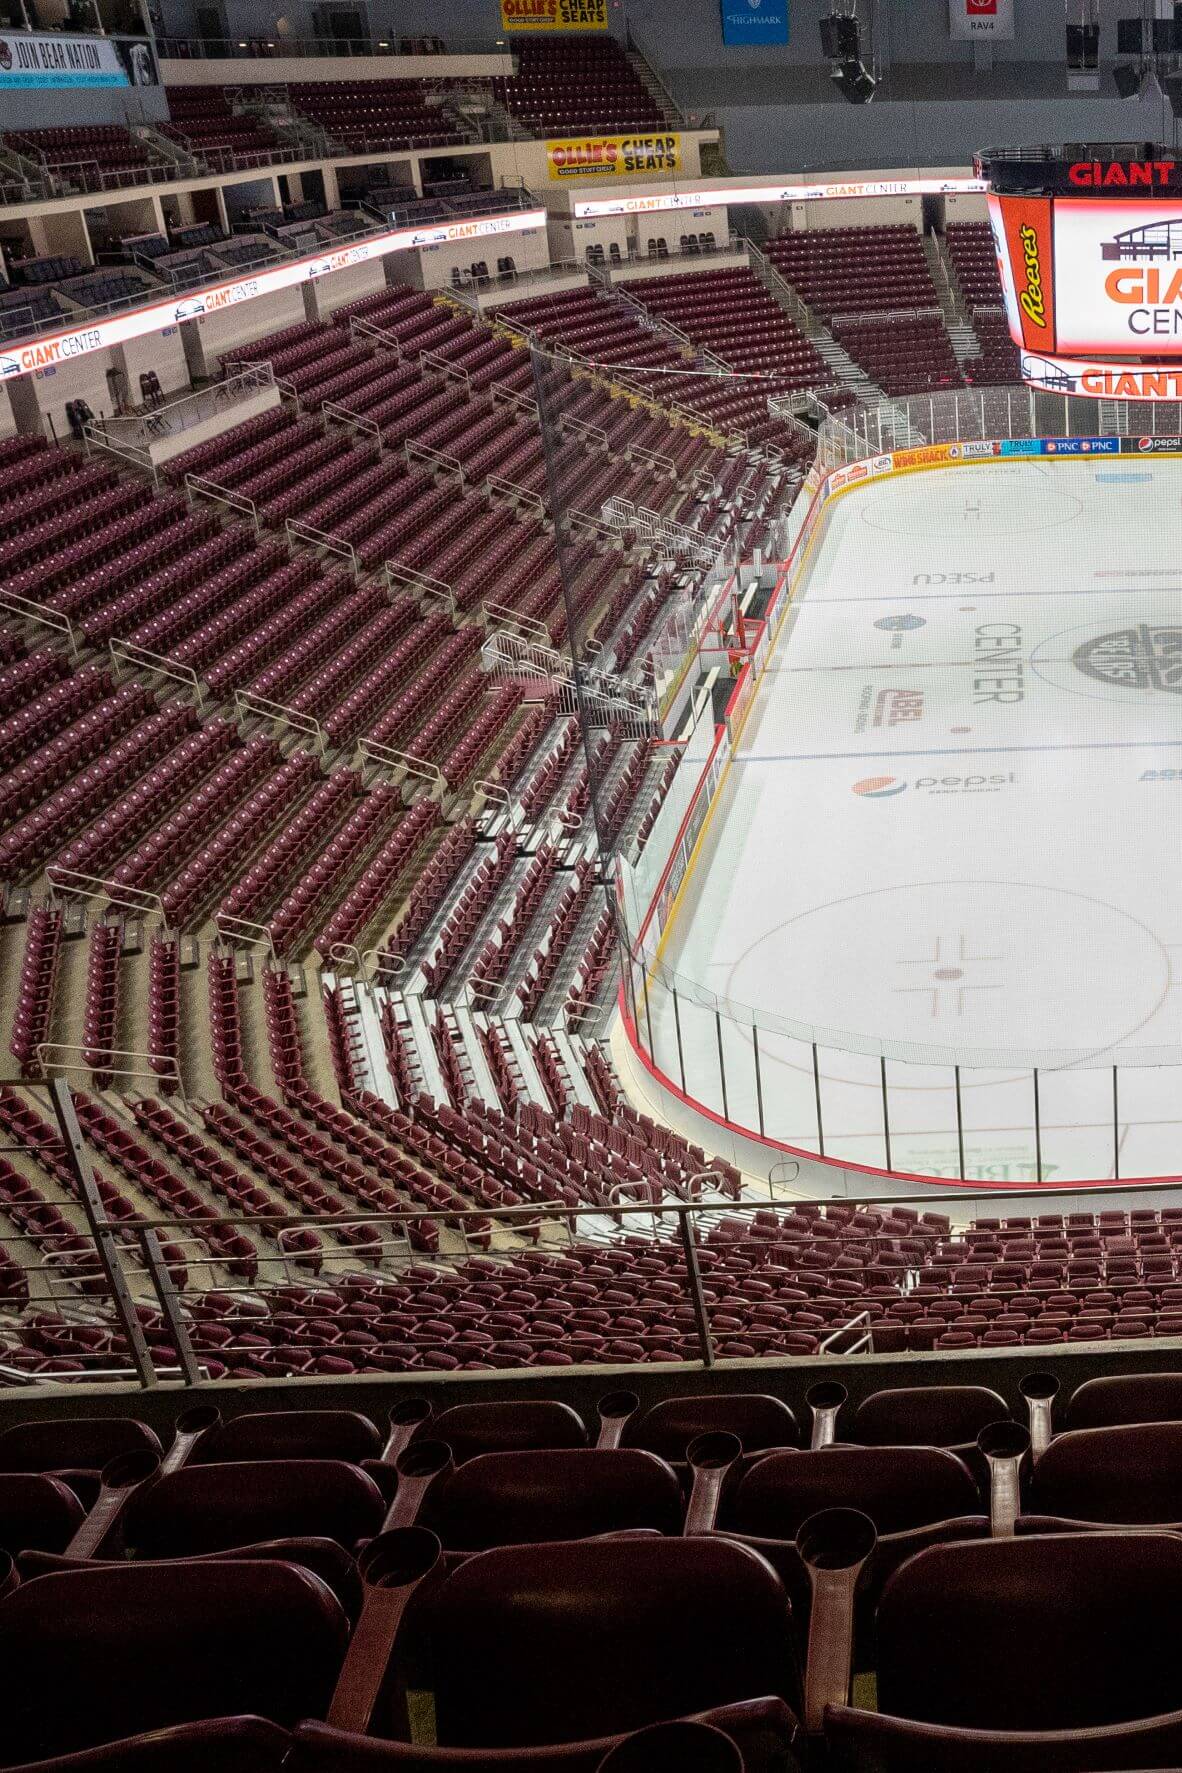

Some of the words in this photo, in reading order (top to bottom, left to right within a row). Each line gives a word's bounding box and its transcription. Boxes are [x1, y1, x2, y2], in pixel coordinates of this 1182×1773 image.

[503, 0, 557, 16] OLLIE'S
[559, 0, 607, 11] CHEAP
[561, 11, 604, 23] SEATS
[728, 15, 782, 25] HIGHMARK
[970, 22, 994, 31] RAV4
[14, 42, 40, 69] JOIN
[39, 43, 67, 69] BEAR
[65, 44, 101, 69] NATION
[553, 141, 617, 166] OLLIE'S
[622, 137, 675, 155] CHEAP
[625, 154, 675, 171] SEATS
[1069, 161, 1174, 186] GIANT
[826, 185, 864, 196] GIANT
[626, 199, 661, 211] GIANT
[448, 224, 478, 239] GIANT
[478, 219, 511, 235] CENTER
[330, 251, 350, 269] GIANT
[1019, 223, 1047, 329] Reese's
[206, 290, 232, 310] GIANT
[232, 281, 258, 302] CENTER
[22, 342, 61, 369] GIANT
[61, 330, 101, 357] CENTER
[964, 443, 990, 453] TRULY
[1057, 442, 1079, 450] PNC
[1092, 441, 1113, 450] PNC
[1154, 437, 1182, 448] pepsi
[913, 571, 995, 585] PSECU
[973, 623, 1024, 705] CENTER
[888, 690, 924, 726] ABEL
[914, 772, 1016, 790] pepsi
